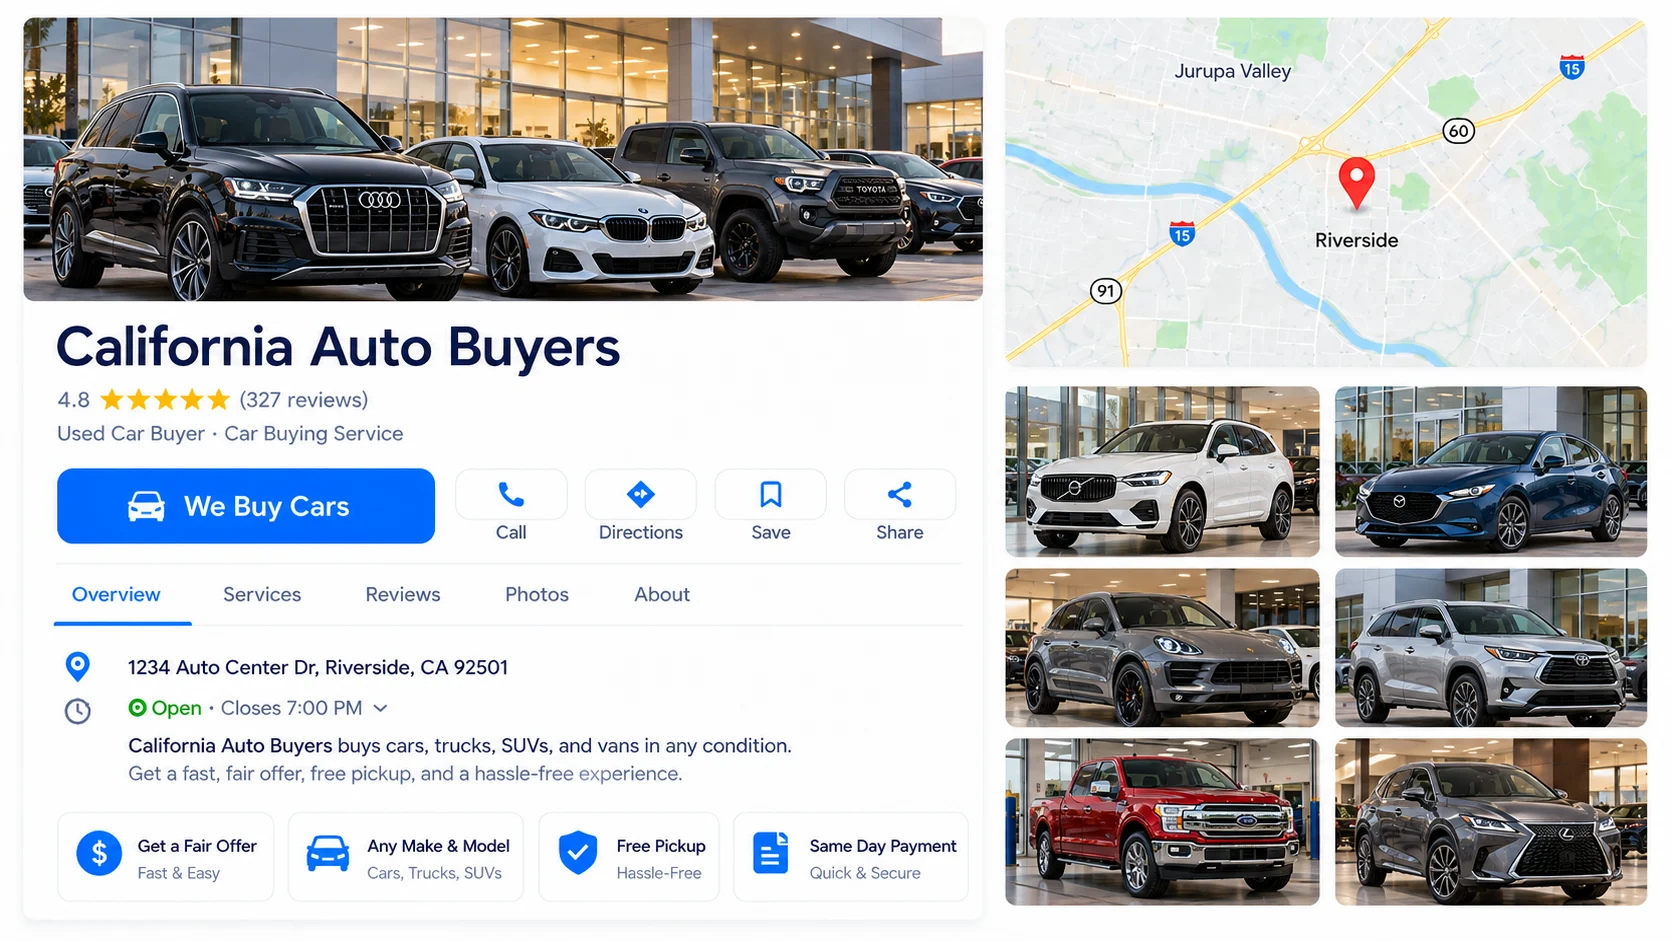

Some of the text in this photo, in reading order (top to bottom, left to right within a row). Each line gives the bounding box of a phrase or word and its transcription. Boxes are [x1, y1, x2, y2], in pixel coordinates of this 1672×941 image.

[1175, 63, 1291, 82] Jurupa Valley
[1565, 64, 1580, 76] 15
[1449, 125, 1469, 138] 60
[856, 186, 887, 194] TOYOTA
[1175, 230, 1190, 242] 15
[1316, 232, 1398, 247] Riverside
[1097, 285, 1115, 298] 91
[57, 324, 620, 377] California Auto Buyers
[58, 390, 368, 410] 4.8 (327 reviews)
[58, 425, 403, 445] Used Car Buyer Car Buying Service
[184, 495, 349, 522] We Buy Cars
[496, 525, 526, 539] Call
[600, 525, 683, 539] Directions
[752, 525, 791, 539] Save
[877, 525, 924, 539] Share
[72, 586, 161, 602] Overview
[224, 586, 301, 602] Services
[367, 586, 440, 602] Reviews
[506, 586, 569, 602] Photos
[634, 586, 690, 602] About
[128, 659, 507, 677] 1234 Auto Center Dr, Riverside, CA 92501
[152, 700, 362, 719] Open Closes 7:00 PM
[129, 737, 791, 757] California Auto Buyers buys cars, trucks, SUVs, and vans in any condition.
[129, 765, 682, 785] Get a fast, fair offer, free pickup, and a hassle-free experience.
[138, 839, 257, 852] Get a Fair Offer
[367, 839, 509, 856] Any Make & Model
[618, 839, 706, 856] Free Pickup
[810, 839, 957, 856] Same Day Payment
[139, 866, 220, 882] Fast & Easy
[368, 866, 502, 881] Cars, Trucks, SUVs
[618, 866, 701, 879] Hassle-Free
[810, 866, 921, 879] Quick & Secure
